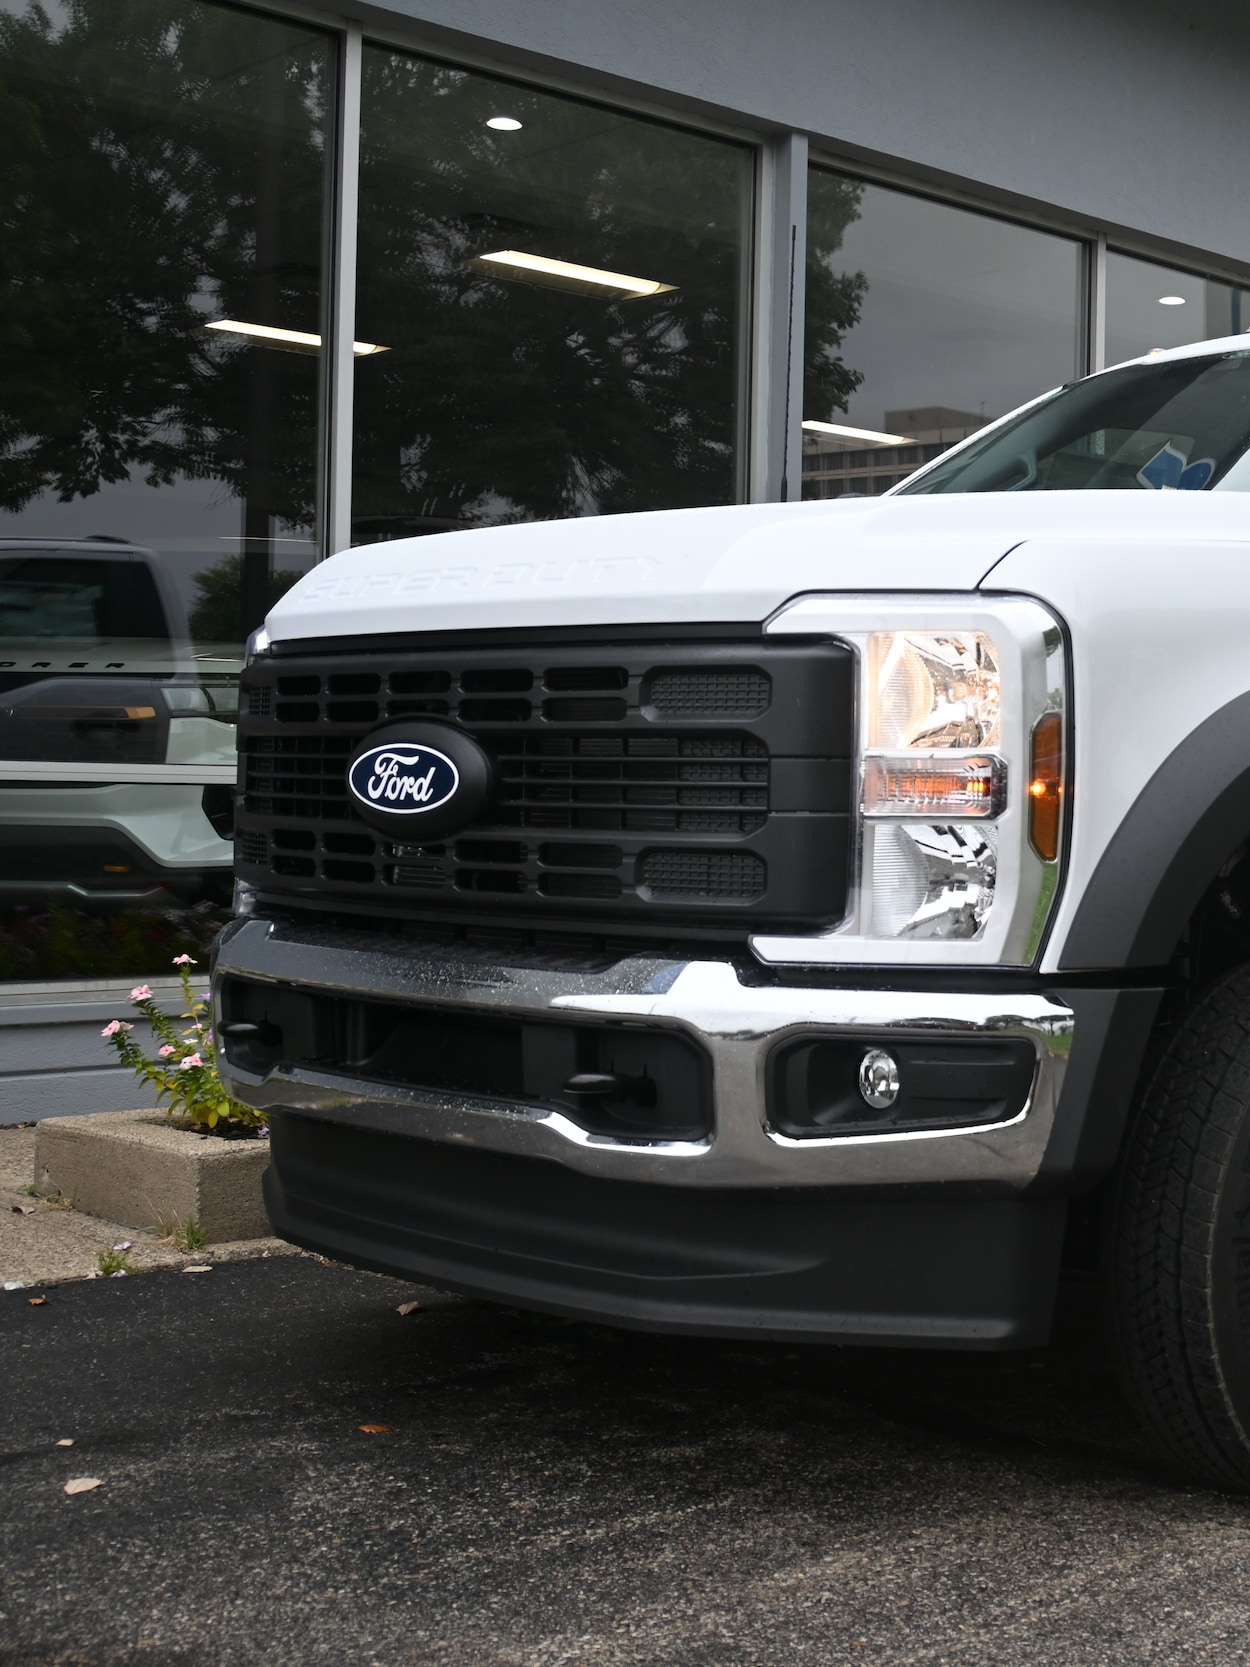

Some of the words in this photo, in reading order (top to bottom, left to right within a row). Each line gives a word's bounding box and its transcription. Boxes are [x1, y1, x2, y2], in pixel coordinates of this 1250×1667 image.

[301, 566, 479, 600] SUPER
[482, 555, 662, 588] DUTY
[367, 752, 436, 802] Ford
